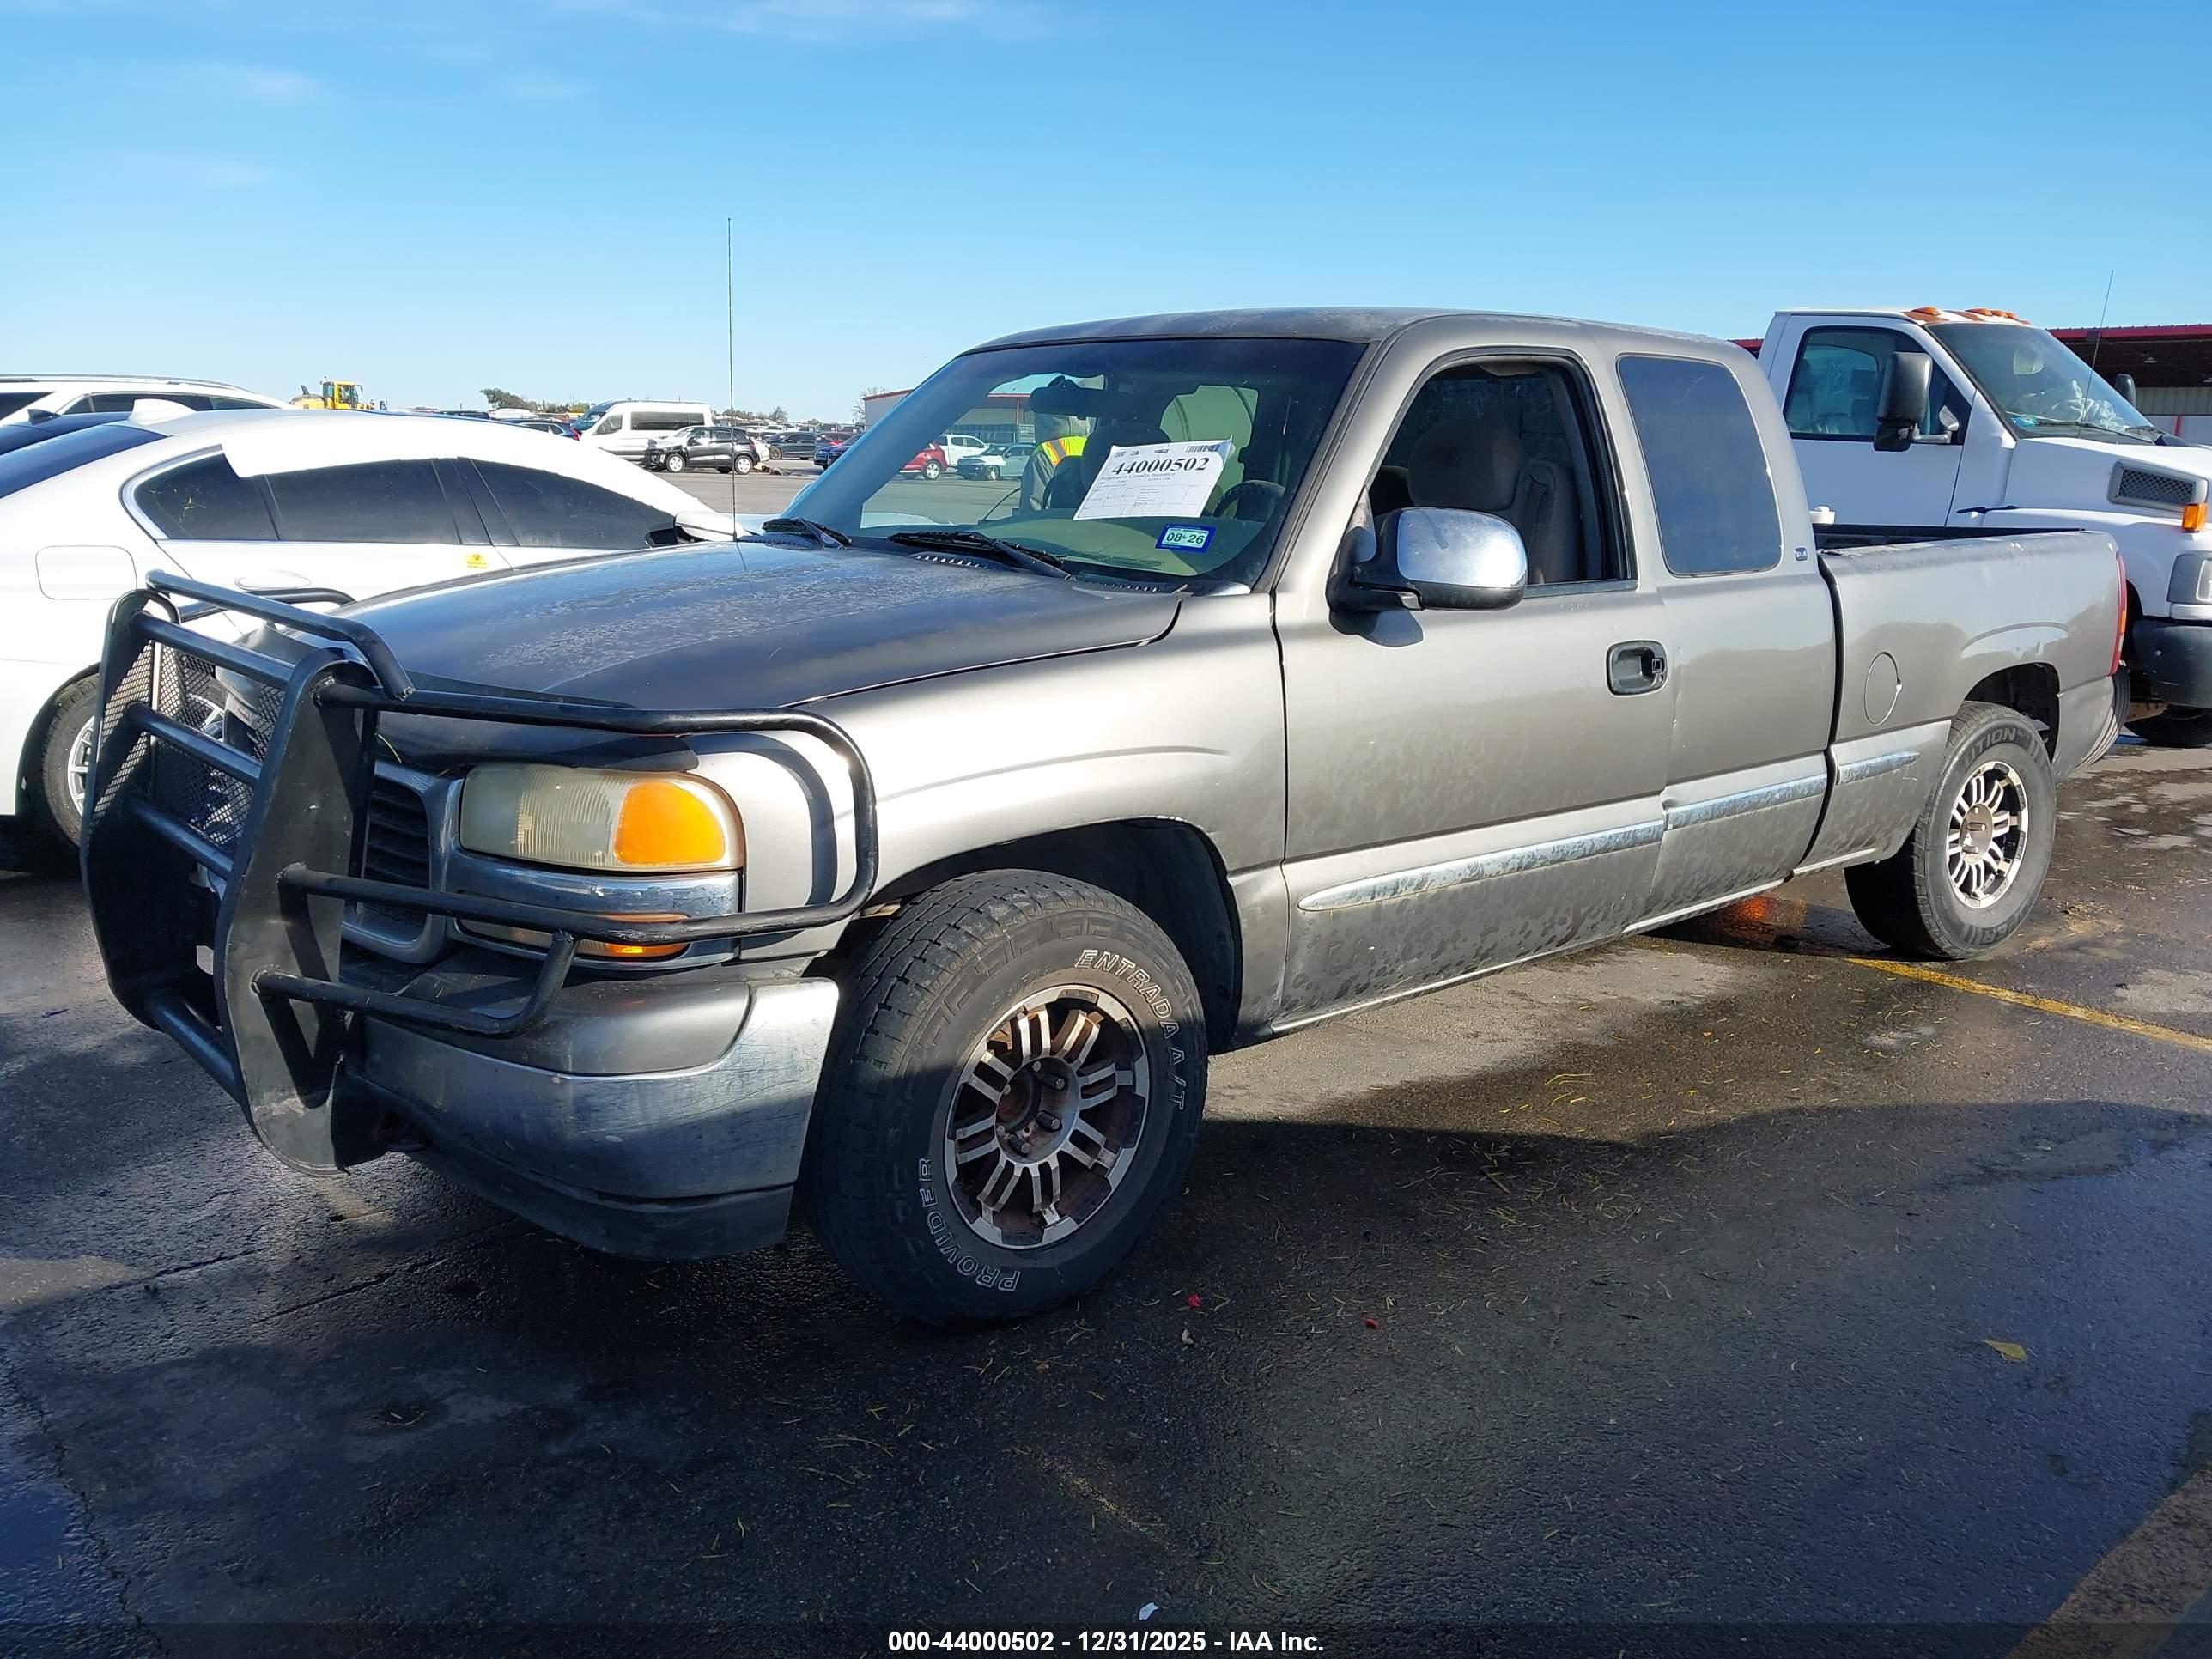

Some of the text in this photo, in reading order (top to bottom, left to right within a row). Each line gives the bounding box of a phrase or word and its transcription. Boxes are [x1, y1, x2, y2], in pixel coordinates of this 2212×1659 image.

[1112, 457, 1210, 475] 44000502
[1166, 532, 1206, 544] 08 26
[1074, 949, 1188, 1111] ENTRADA A/T
[919, 1158, 1022, 1291] PROVIDER
